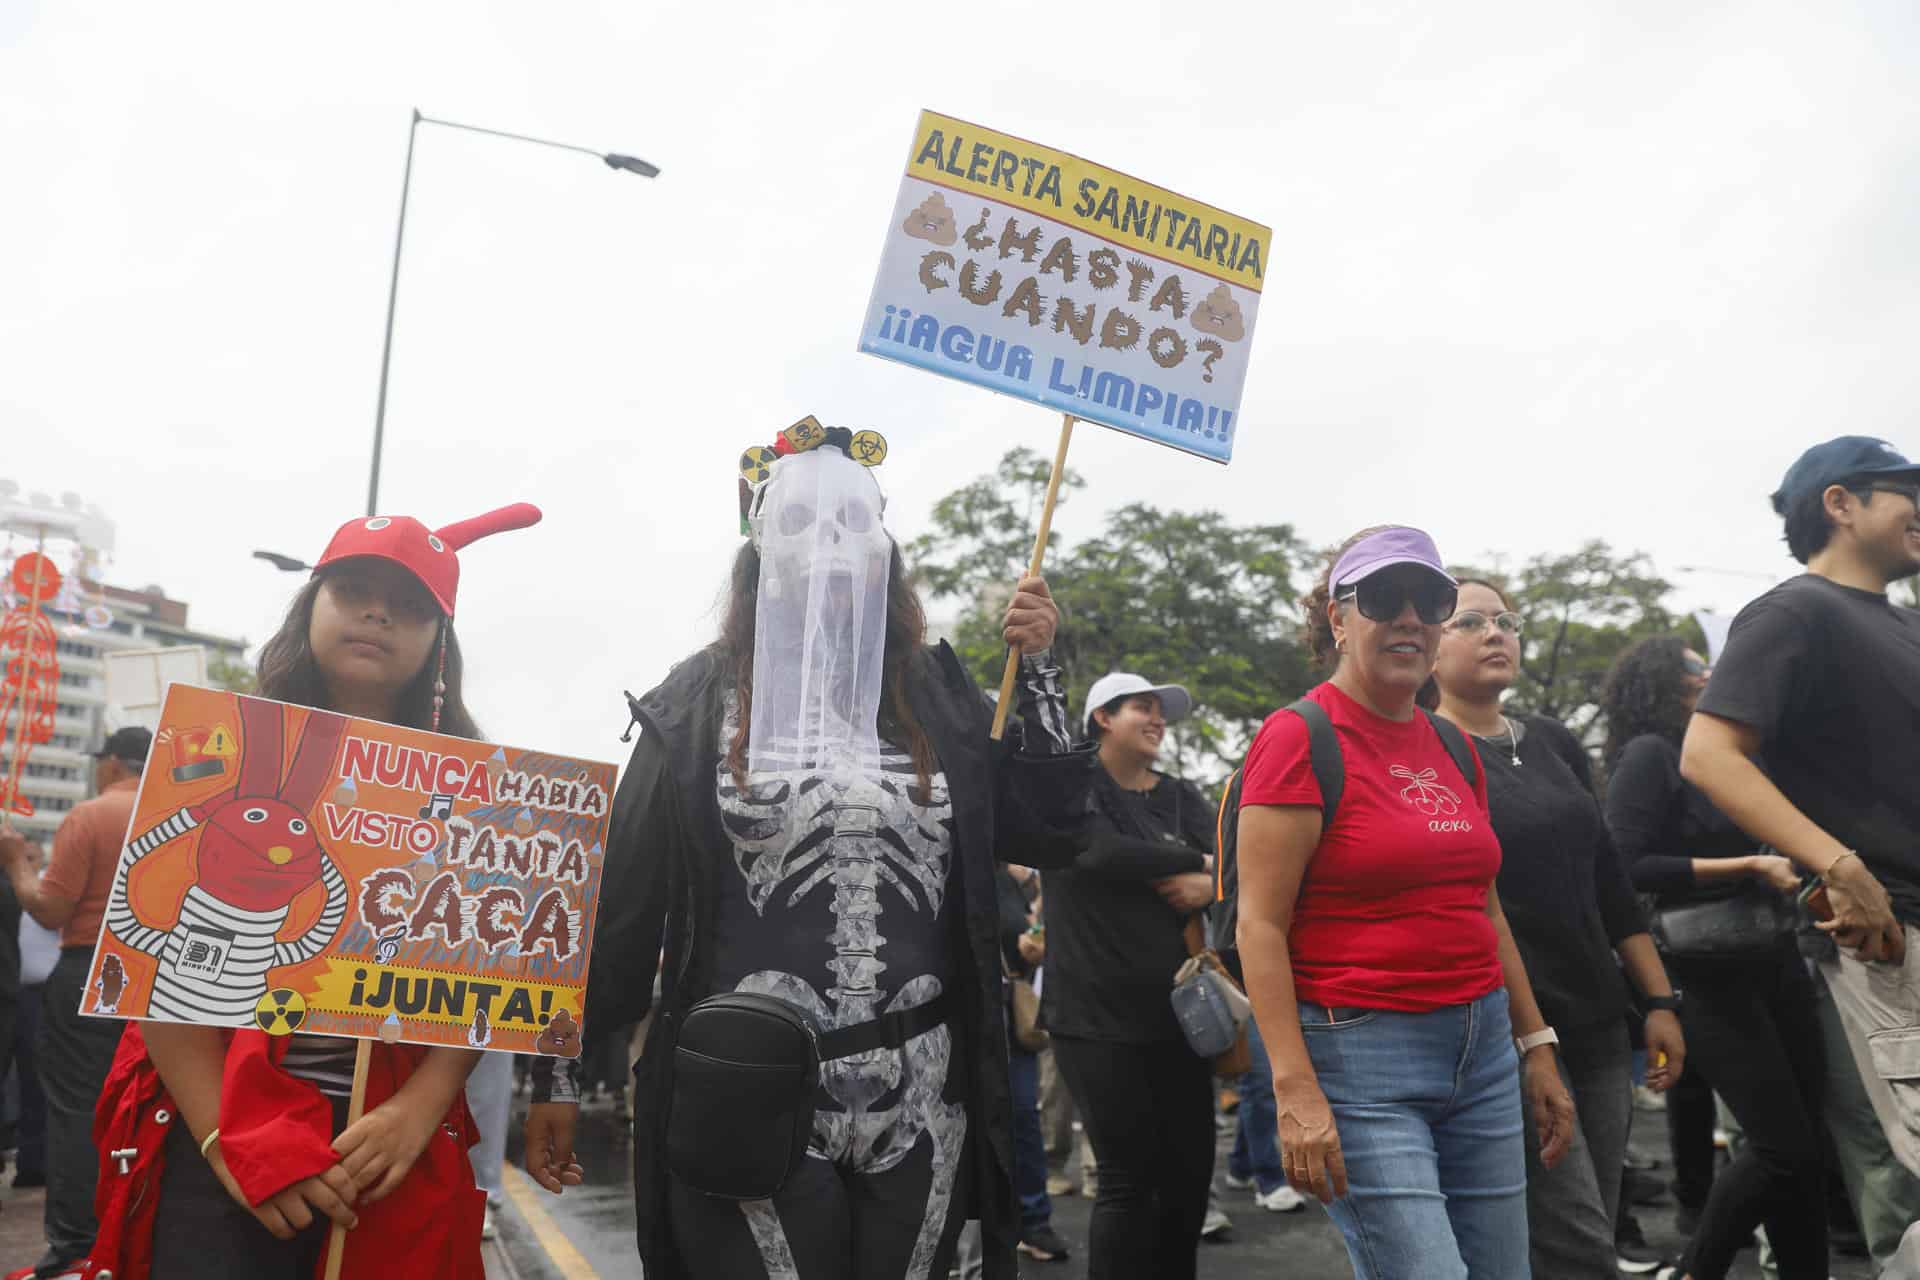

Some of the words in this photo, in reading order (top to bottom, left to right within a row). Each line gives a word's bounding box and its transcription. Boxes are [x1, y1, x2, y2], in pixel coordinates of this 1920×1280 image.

[916, 129, 1063, 208] ALERTA
[1073, 178, 1262, 279] SANITARIA
[962, 207, 1190, 320] ¿HASTA
[918, 249, 1224, 383] CUANDO?
[1047, 357, 1233, 442] LIMPIA!!
[340, 736, 492, 804] NUNCA
[496, 771, 608, 817] HABÍA
[324, 803, 438, 854] VISTO
[446, 816, 588, 885] TANTA
[184, 940, 222, 966] 31
[359, 868, 582, 961] CACA
[348, 968, 554, 1027] ¡JUNTA!
